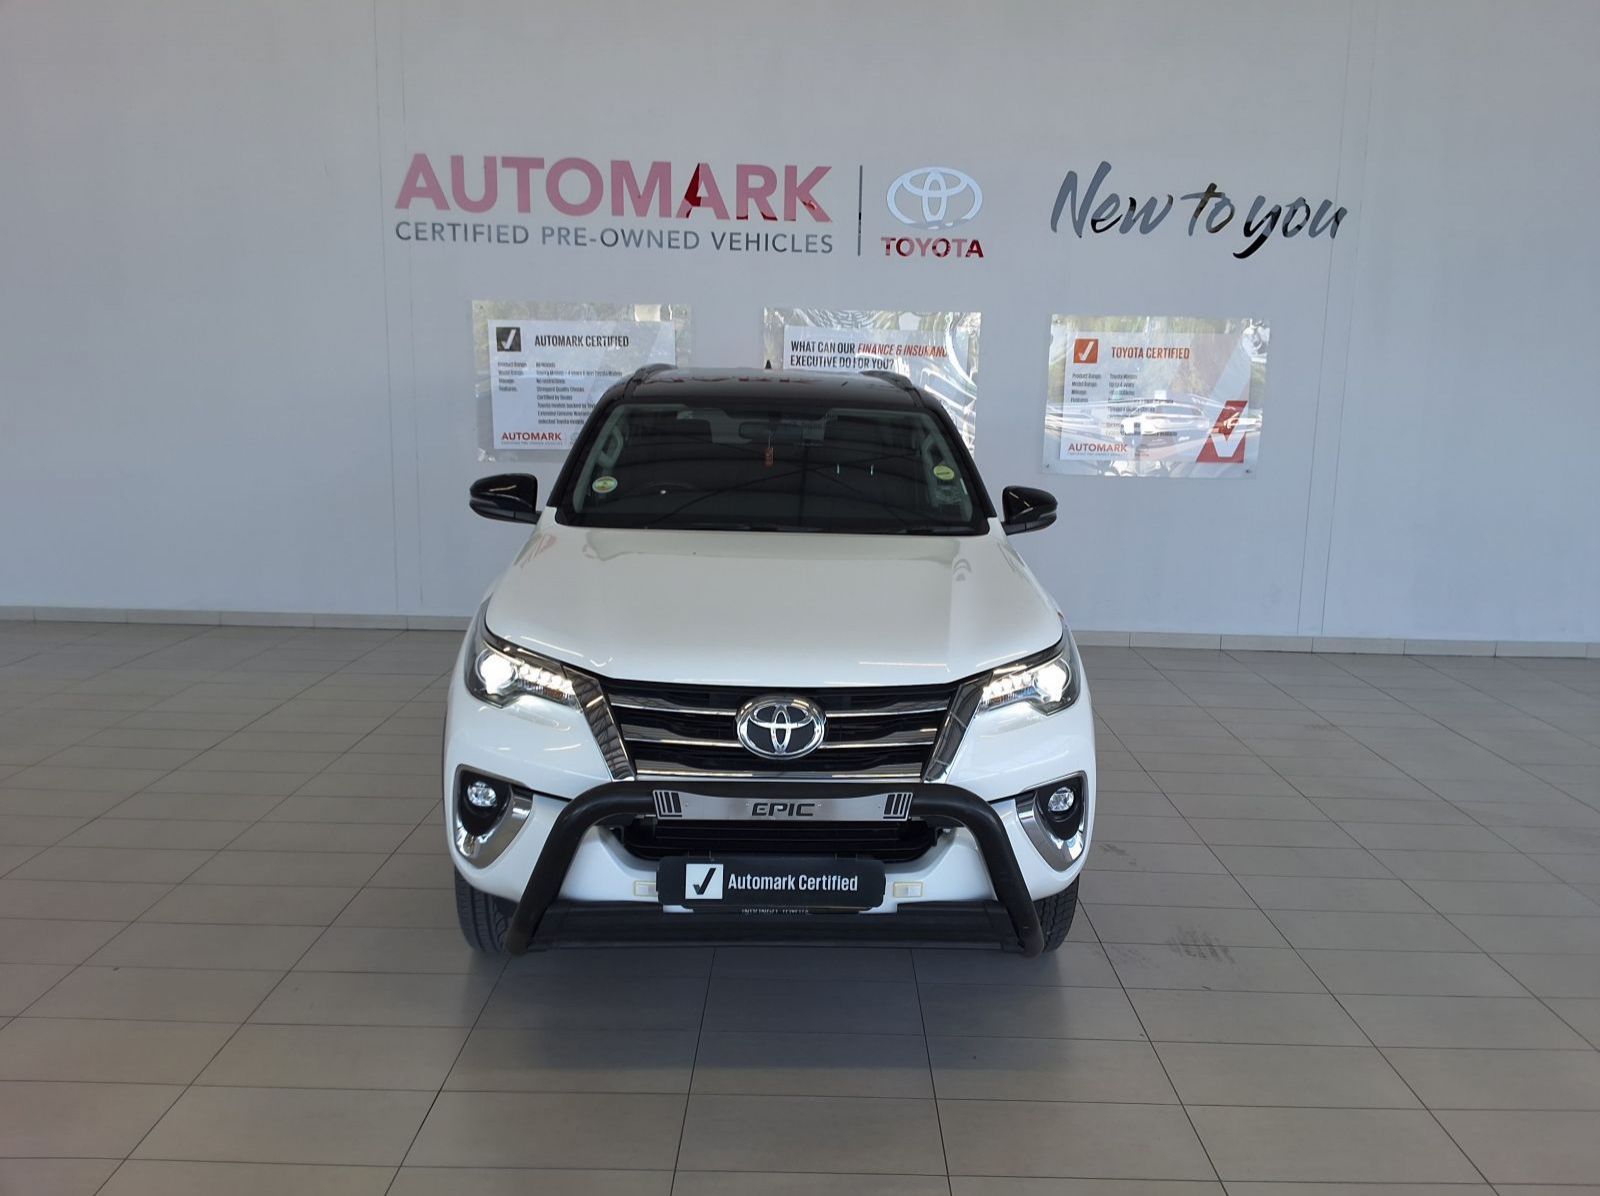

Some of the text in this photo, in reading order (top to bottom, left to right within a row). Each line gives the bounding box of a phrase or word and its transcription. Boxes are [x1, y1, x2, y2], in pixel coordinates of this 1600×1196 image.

[394, 153, 833, 223] AUTOMARK
[1050, 161, 1348, 259] New to you
[395, 221, 833, 254] CERTIFIED PRE-OWNED VEHICLES
[881, 236, 984, 259] TOYOTA
[534, 335, 629, 348] AUTOMARK CERTIFIED
[791, 340, 816, 353] WHAT
[817, 341, 837, 354] CAN
[837, 342, 856, 355] OUR
[857, 343, 894, 356] FINANCE
[903, 344, 948, 358] INSURANC
[1111, 346, 1190, 360] TOYOTA CERTIFIED
[790, 355, 895, 370] EXECUTIVE DO FOR YOU?
[501, 431, 562, 441] AUTOMARK
[1068, 443, 1128, 453] AUTOMARK
[751, 802, 816, 817] EPIC
[728, 873, 858, 892] Automark Certified
